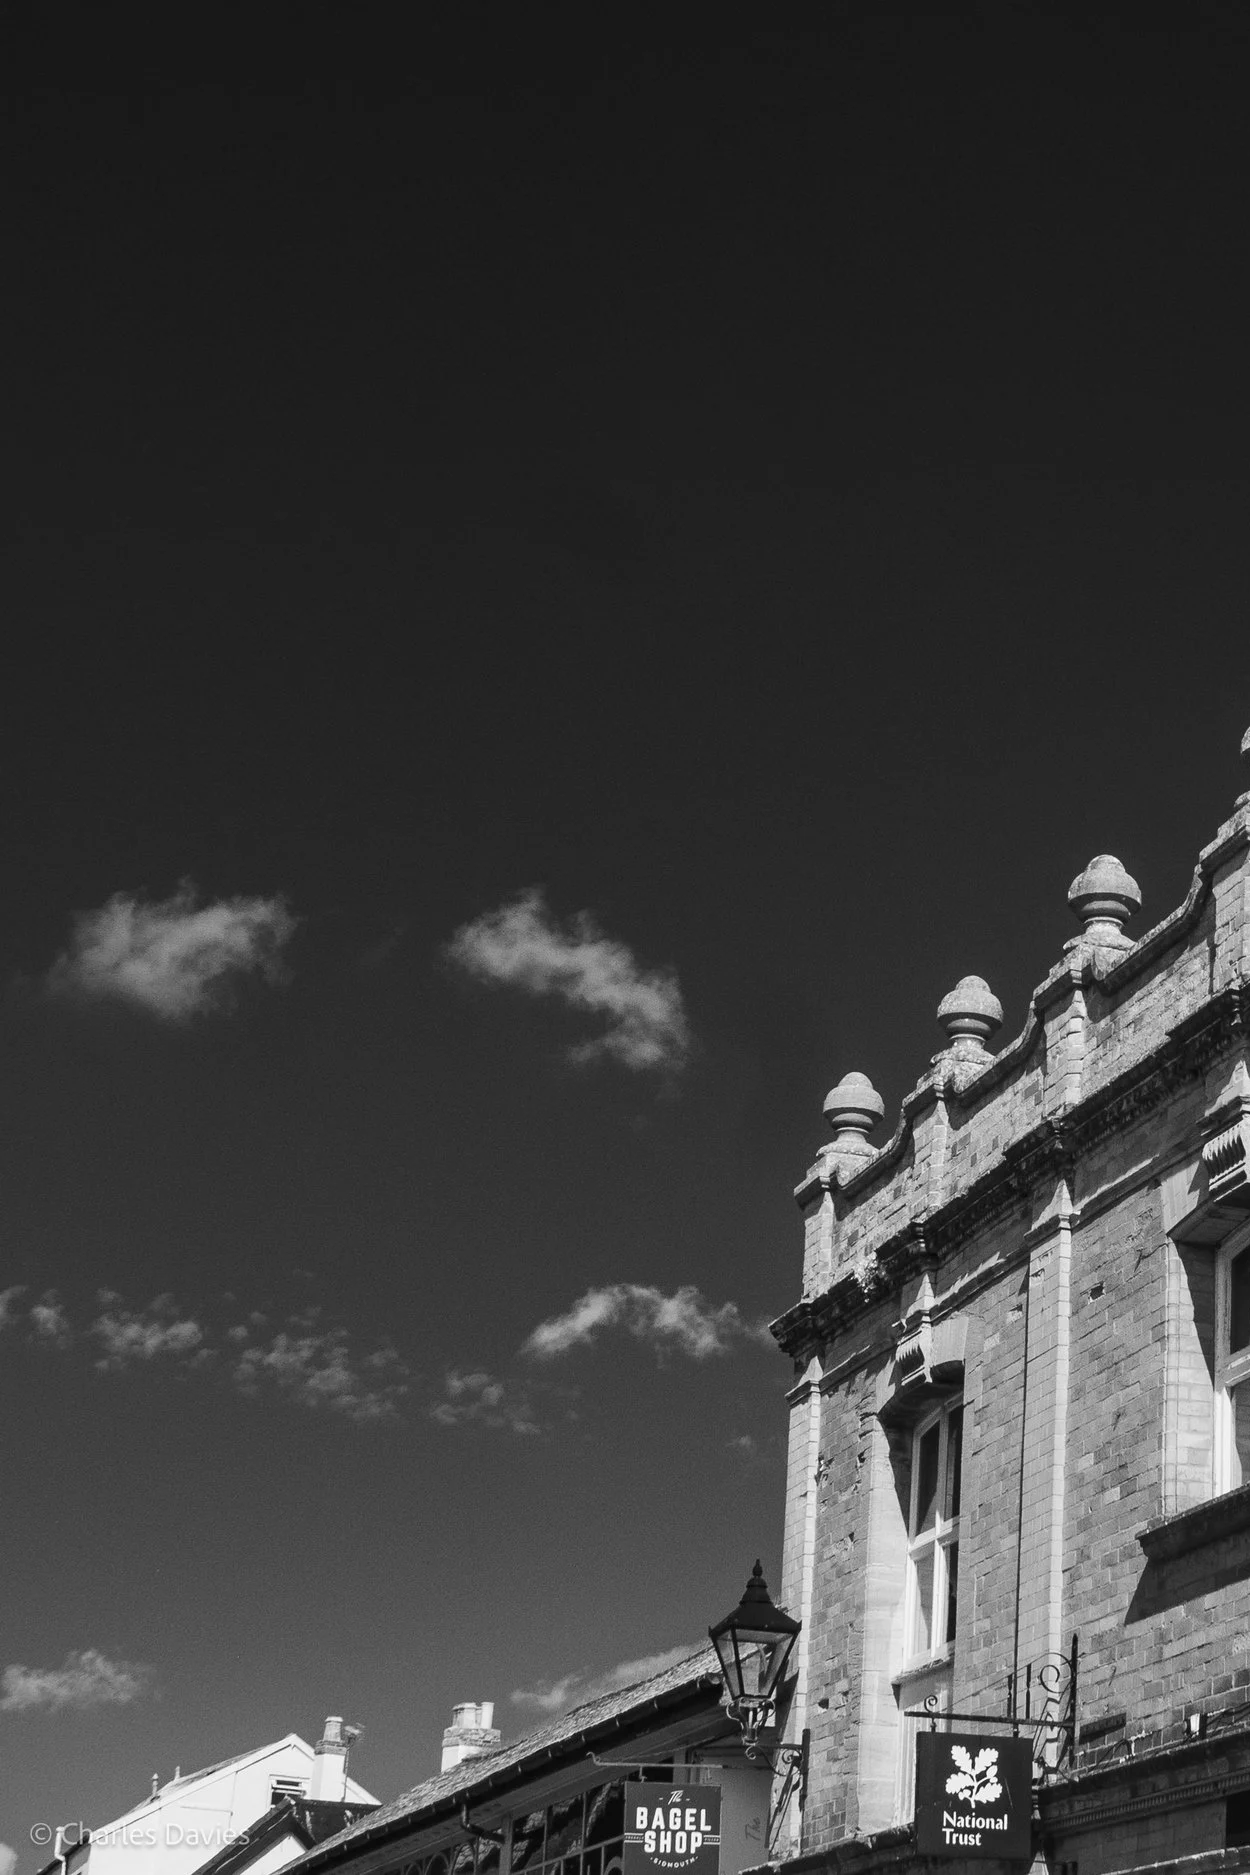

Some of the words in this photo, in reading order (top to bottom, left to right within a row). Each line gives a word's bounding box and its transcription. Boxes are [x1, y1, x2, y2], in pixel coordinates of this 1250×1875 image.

[636, 1807, 712, 1831] BAGEL
[943, 1811, 1008, 1830] National
[644, 1831, 703, 1854] SHOP
[942, 1828, 982, 1846] Trust
